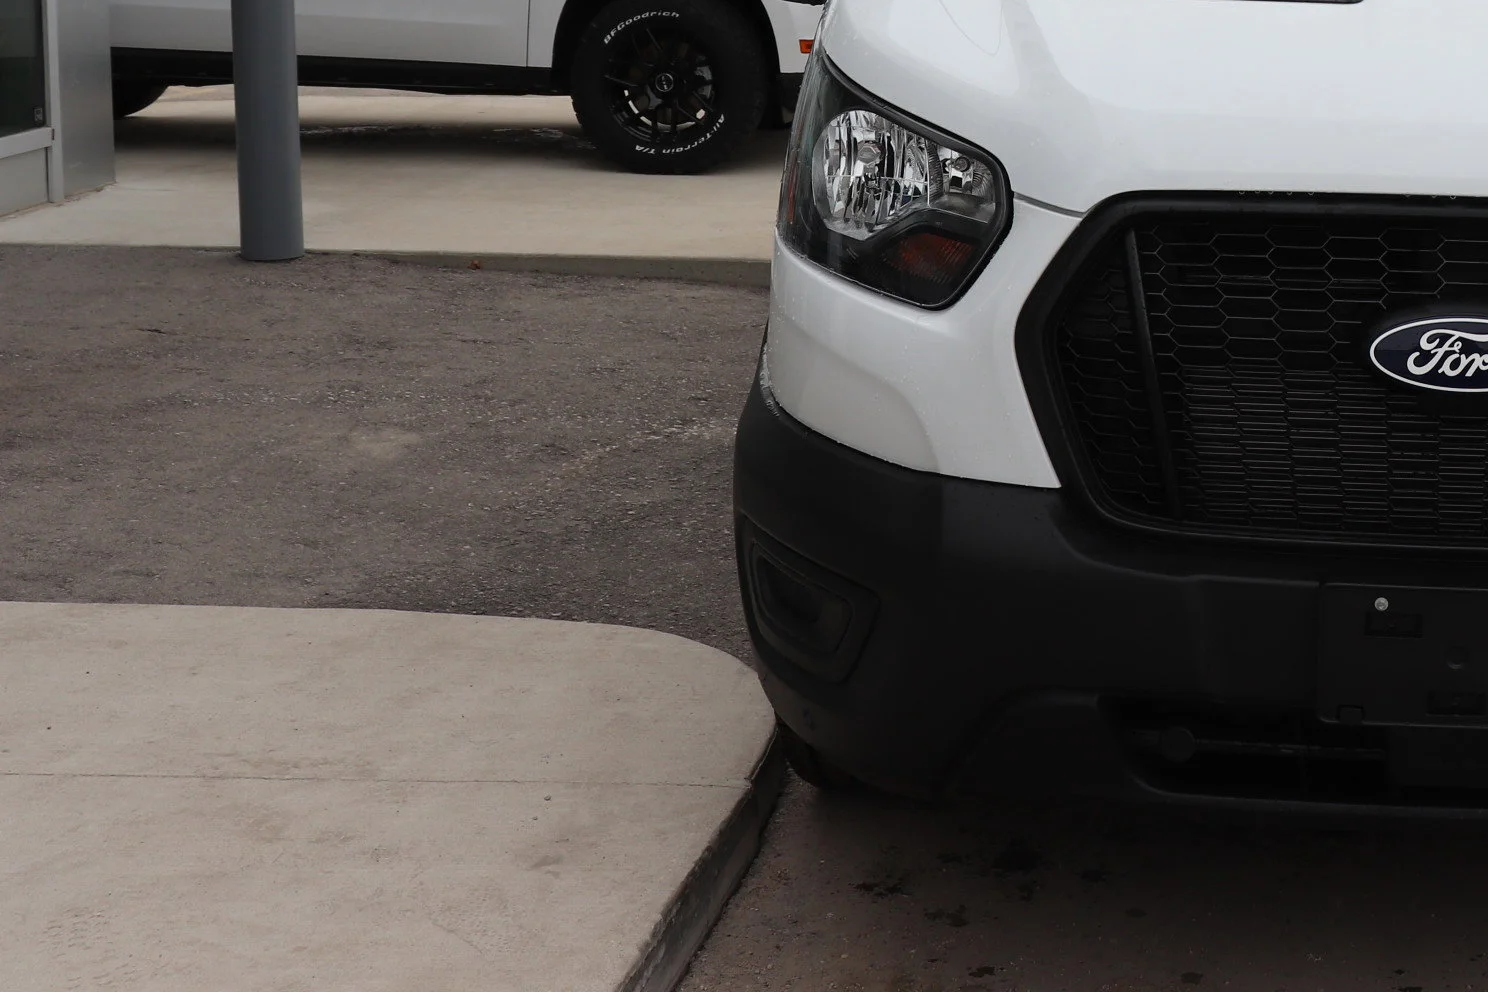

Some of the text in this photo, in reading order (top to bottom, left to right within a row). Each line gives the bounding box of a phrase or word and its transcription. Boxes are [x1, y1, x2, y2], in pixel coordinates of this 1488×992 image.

[603, 10, 680, 44] BFGoodrich
[635, 114, 725, 154] All-Terrain T/A
